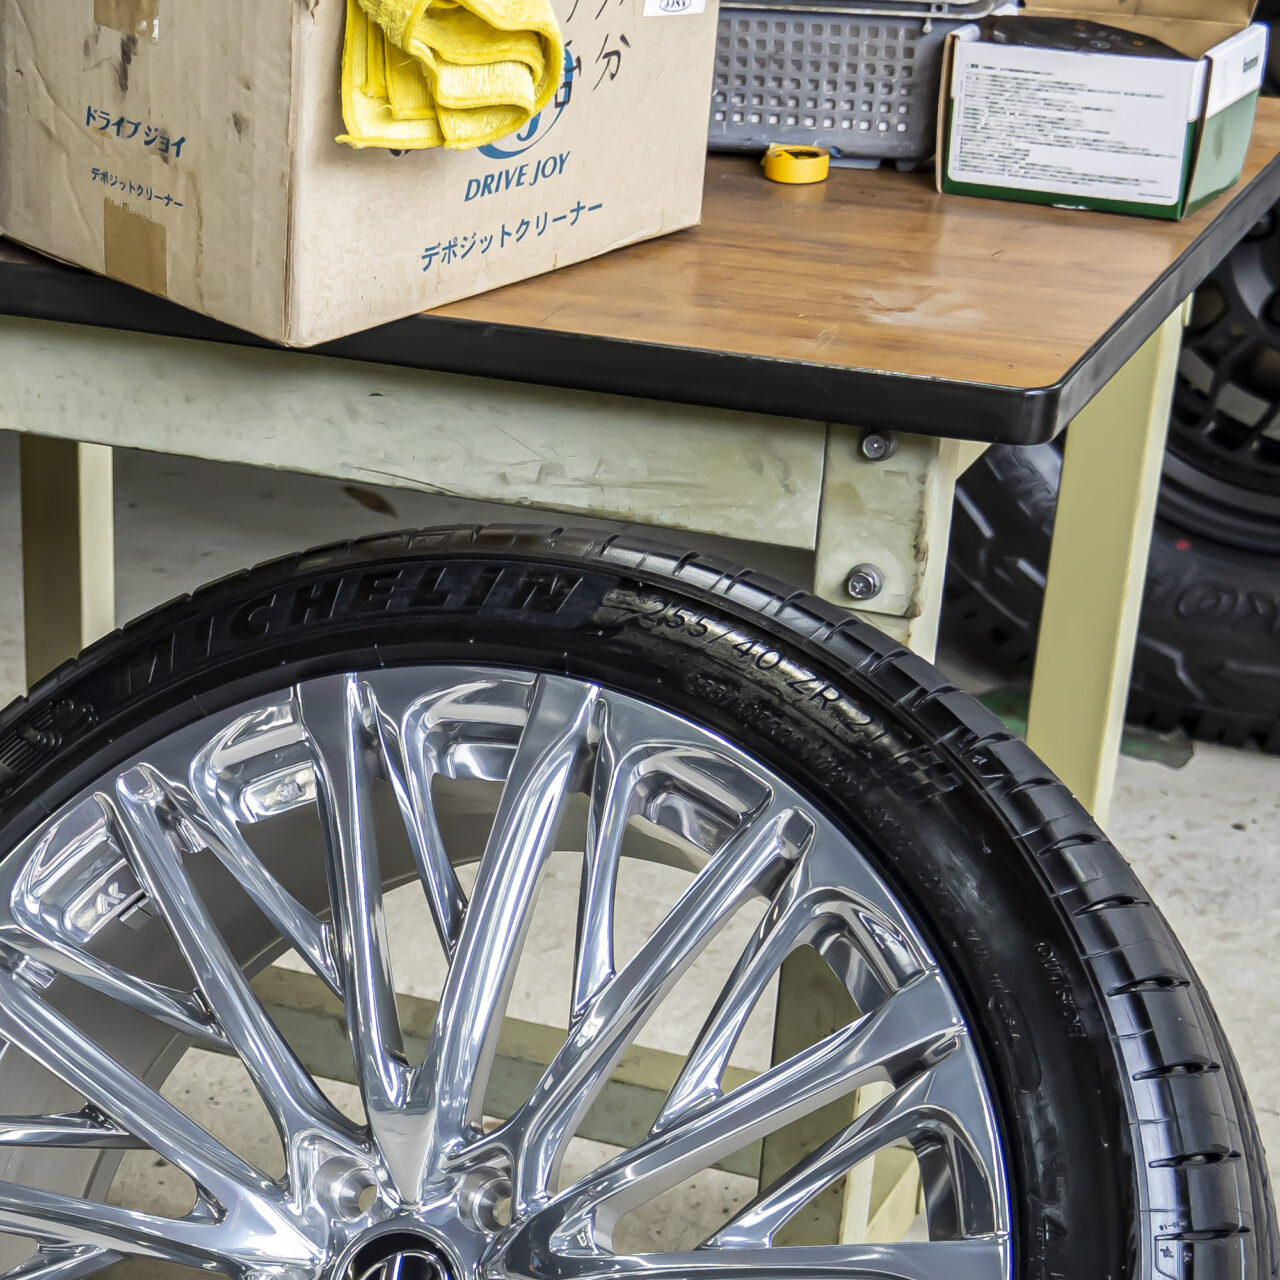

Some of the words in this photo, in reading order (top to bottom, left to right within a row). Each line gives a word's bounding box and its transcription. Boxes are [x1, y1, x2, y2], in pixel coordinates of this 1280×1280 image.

[464, 163, 529, 202] DRIVE
[528, 151, 570, 187] JOY
[421, 200, 603, 272] デポジットクリーナー
[128, 566, 584, 693] MICHELIN
[641, 601, 783, 671] 255/40
